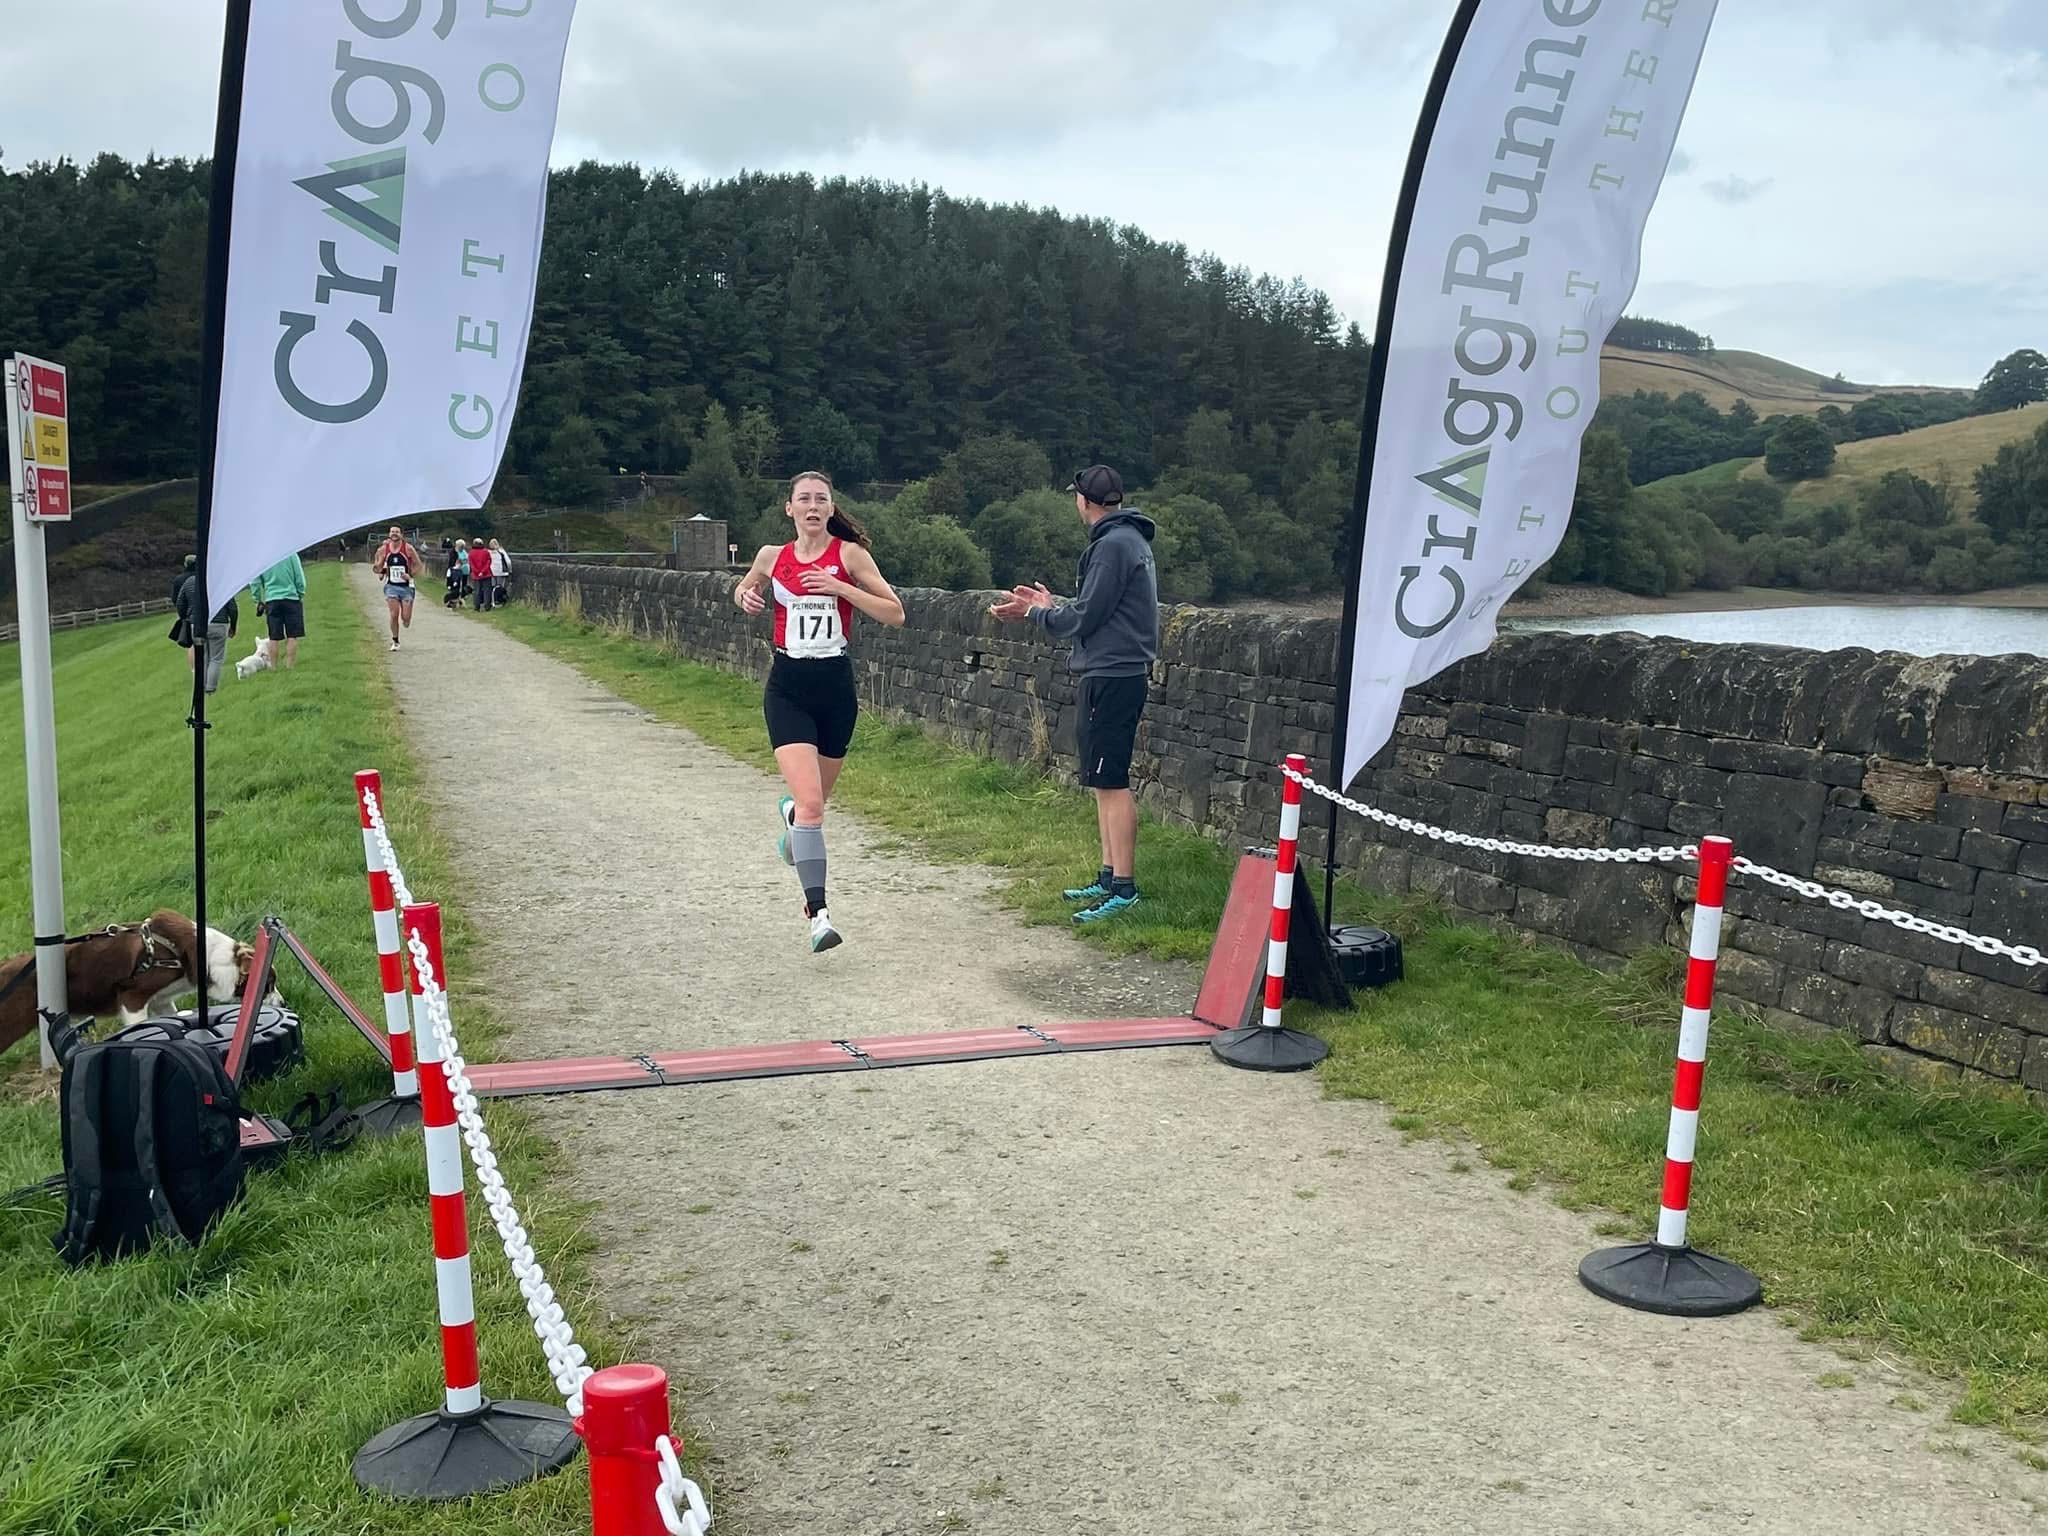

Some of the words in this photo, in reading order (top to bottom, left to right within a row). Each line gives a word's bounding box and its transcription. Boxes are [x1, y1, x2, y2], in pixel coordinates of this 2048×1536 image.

[1546, 270, 1600, 420] OUT
[1588, 0, 1679, 191] THER
[448, 239, 505, 440] GET
[799, 615, 832, 640] 171
